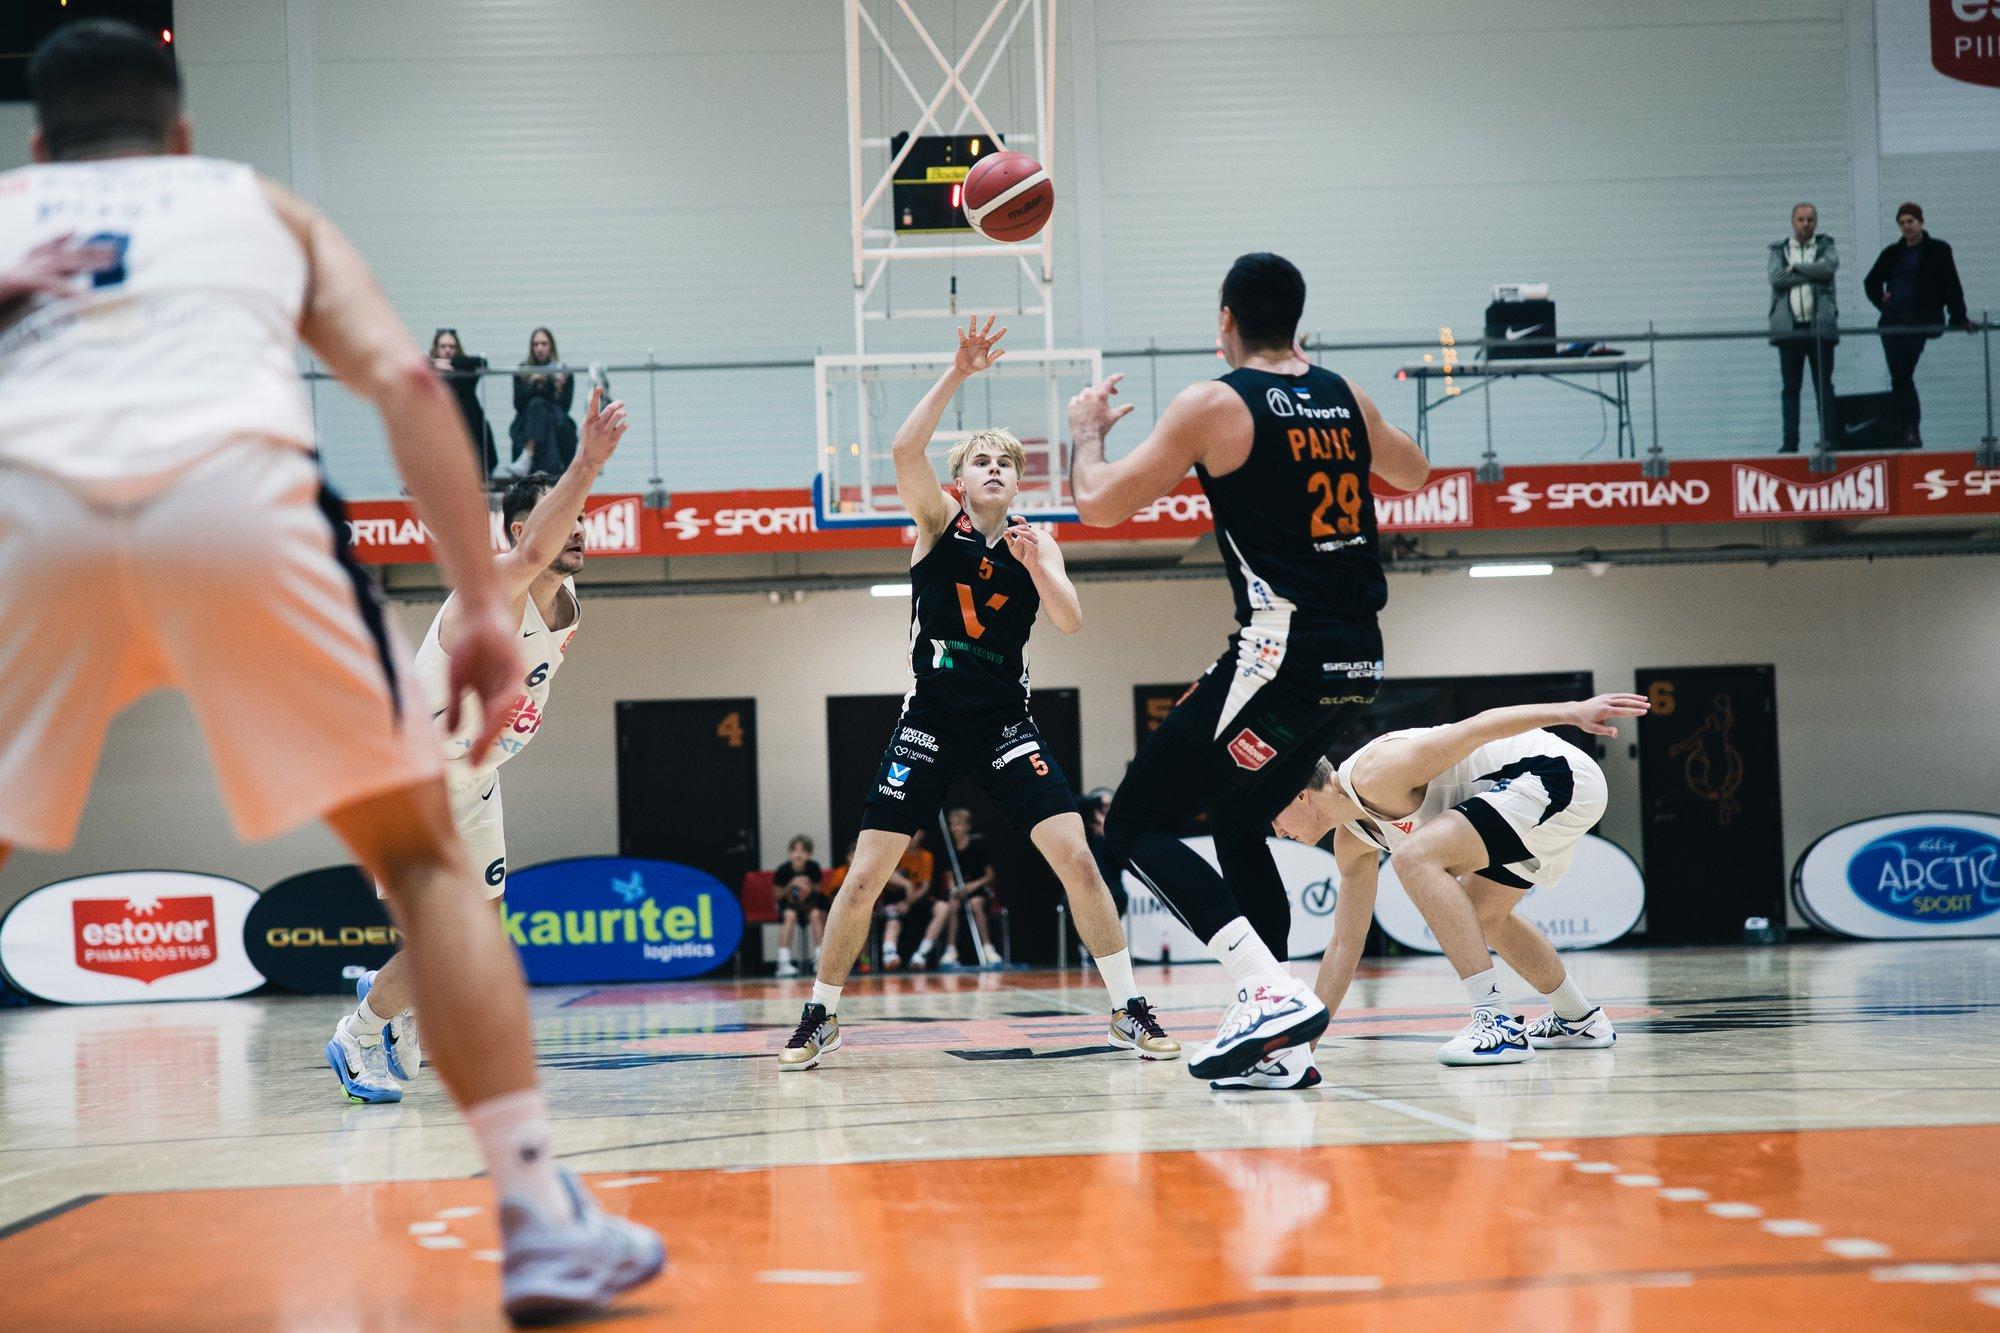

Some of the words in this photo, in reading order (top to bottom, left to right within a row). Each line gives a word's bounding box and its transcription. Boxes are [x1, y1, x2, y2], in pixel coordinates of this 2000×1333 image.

[1008, 194, 1044, 220] molten
[1295, 403, 1351, 419] favorte
[1374, 475, 1469, 525] VIIMSI
[1546, 479, 1711, 510] SPORTLAND
[1737, 468, 1782, 513] KK
[1786, 464, 1885, 512] VIIMSI
[1307, 471, 1362, 537] 29
[978, 556, 994, 581] 5
[524, 662, 550, 688] 6
[1648, 680, 1676, 717] 6
[716, 711, 744, 748] 4
[899, 732, 940, 752] MOTORS
[902, 726, 936, 743] UNITED
[1029, 752, 1050, 776] 5
[878, 784, 906, 801] VIIMSI
[484, 857, 506, 887] 6
[1877, 856, 2000, 892] ARCTIC
[1912, 894, 1974, 915] SPORT
[82, 917, 209, 947] estover
[500, 893, 714, 945] kauritel
[84, 945, 211, 963] PIIMATÖÖSTUS
[643, 941, 716, 963] logistics
